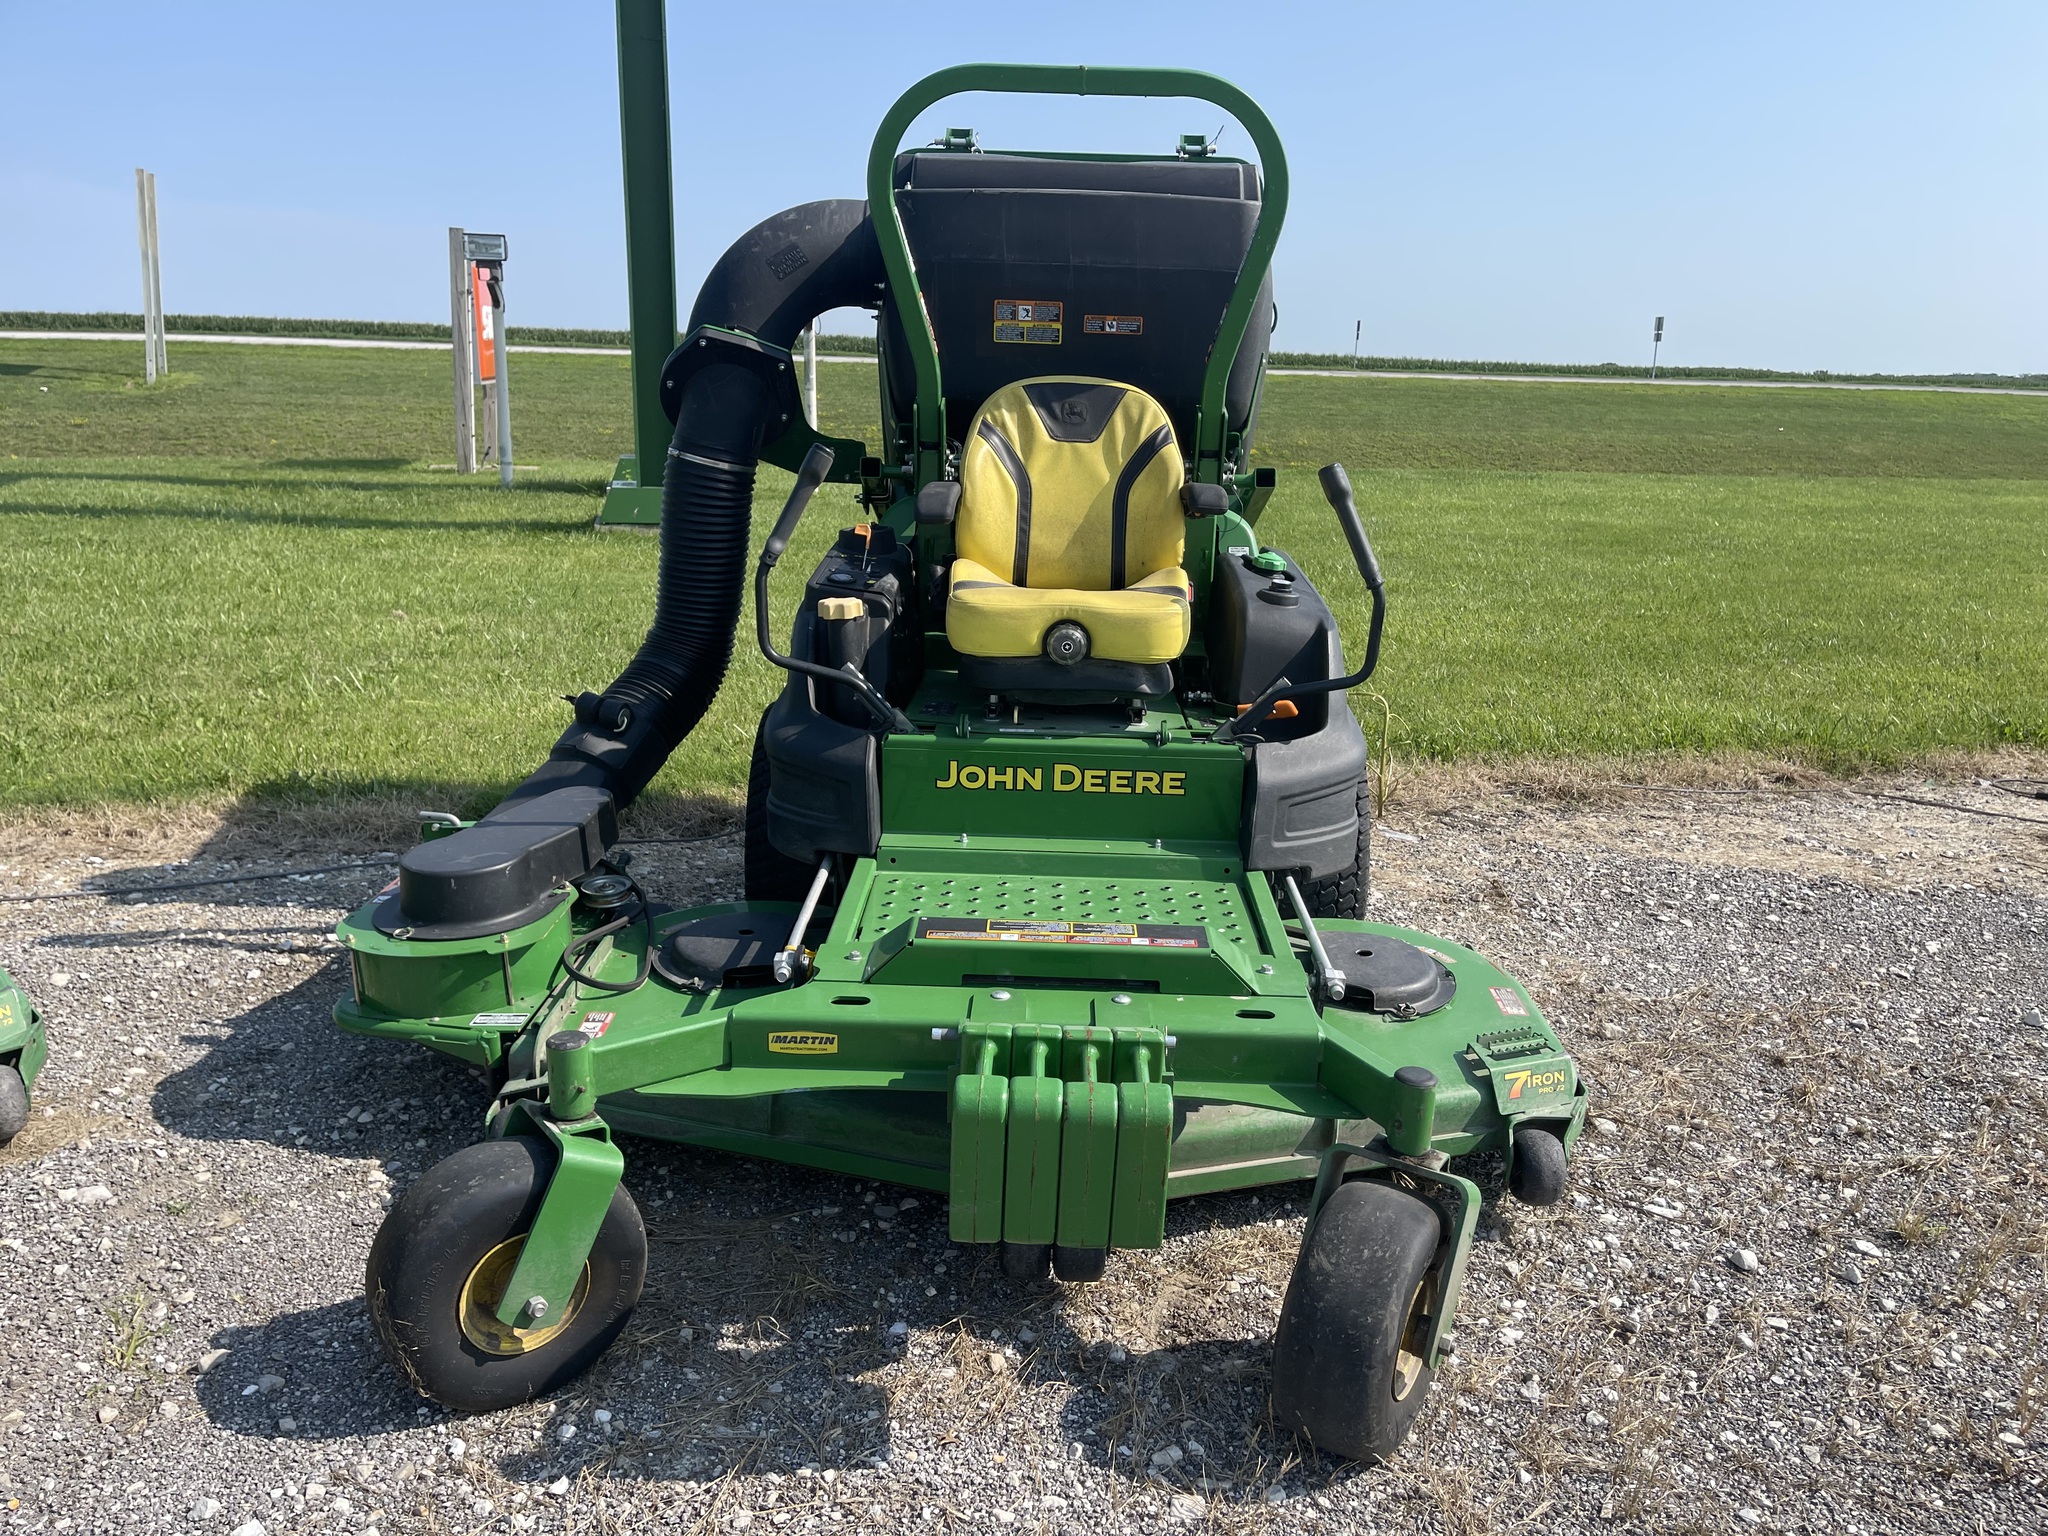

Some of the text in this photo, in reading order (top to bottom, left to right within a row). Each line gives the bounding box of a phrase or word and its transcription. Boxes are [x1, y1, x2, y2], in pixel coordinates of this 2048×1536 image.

[935, 760, 1186, 795] JOHN DEERE
[772, 1035, 836, 1045] MARTIN
[1538, 1086, 1554, 1094] PRO
